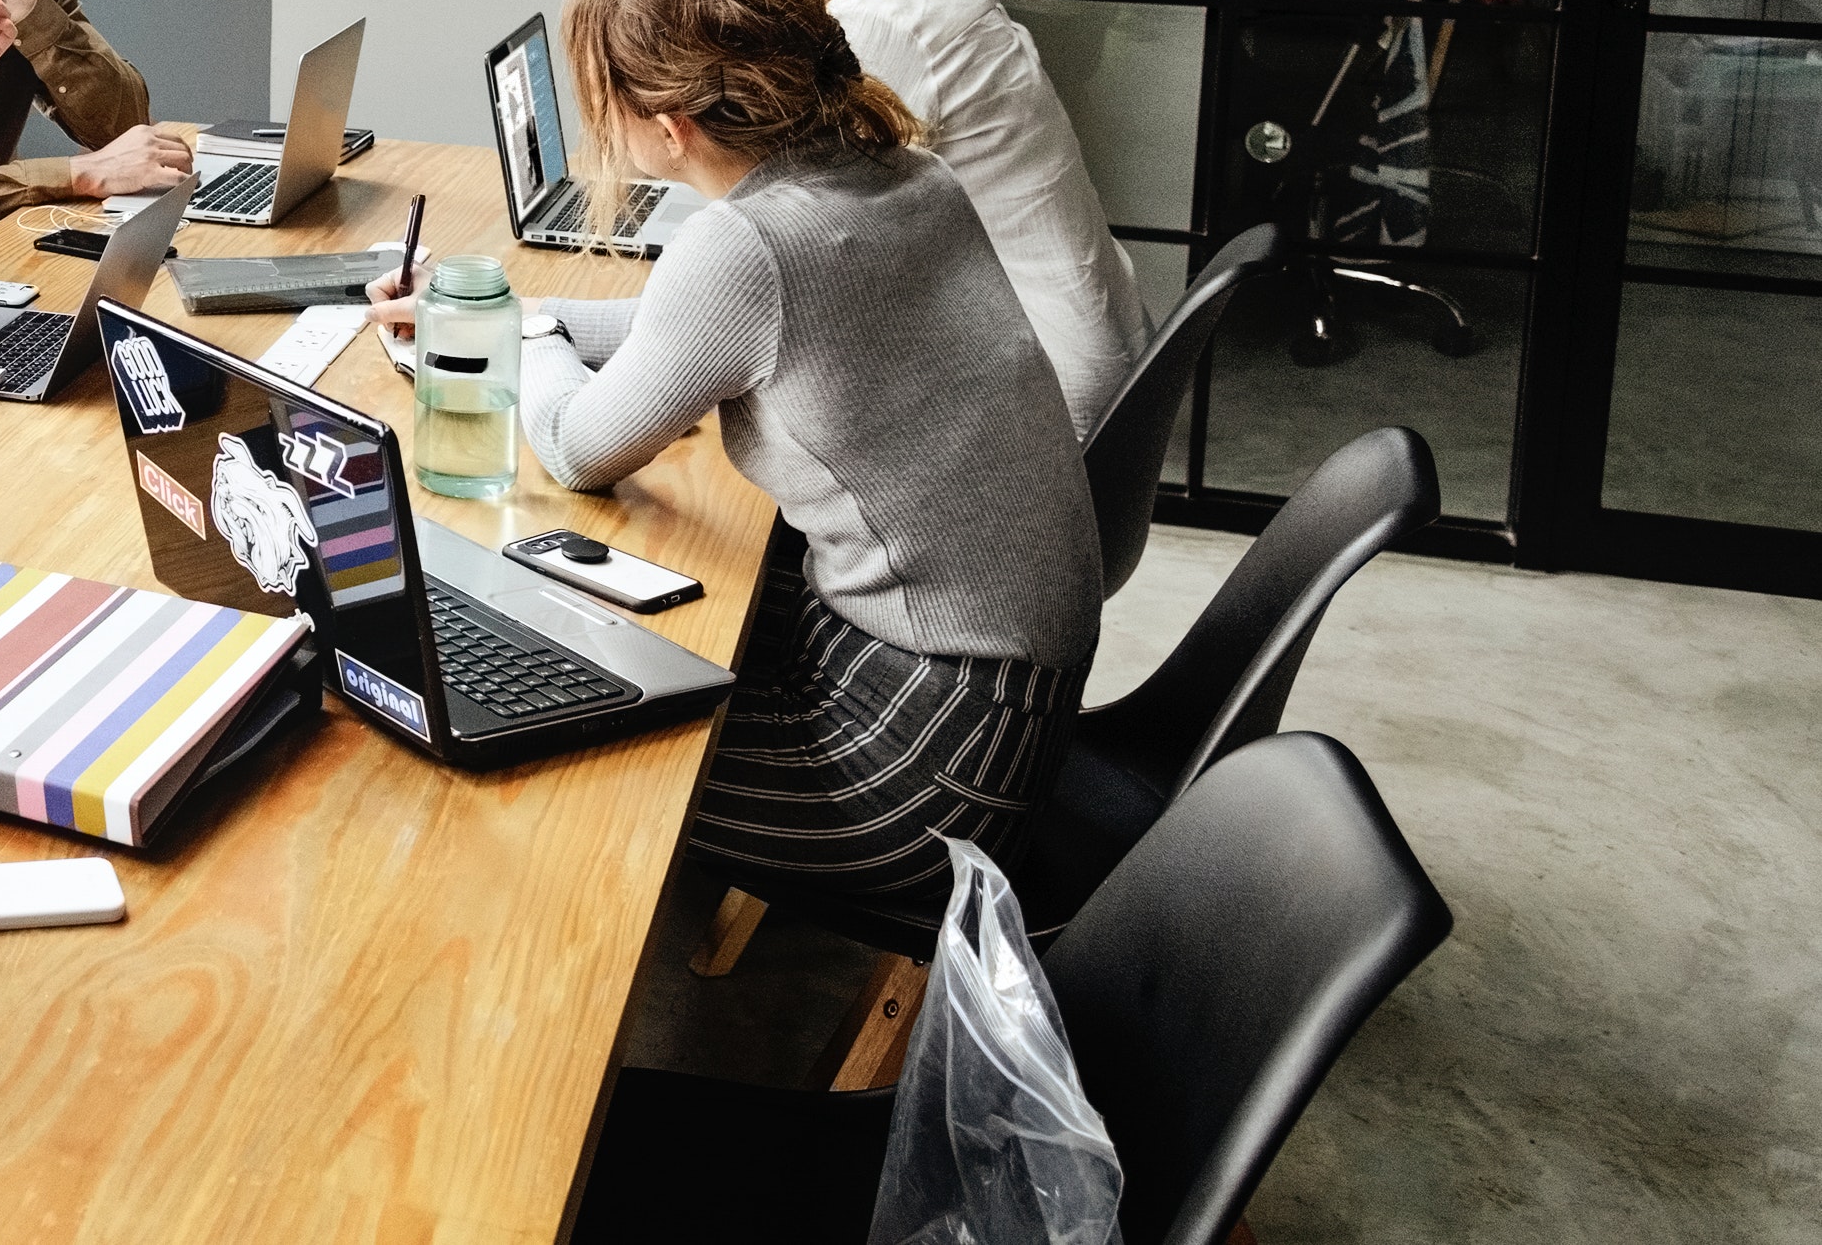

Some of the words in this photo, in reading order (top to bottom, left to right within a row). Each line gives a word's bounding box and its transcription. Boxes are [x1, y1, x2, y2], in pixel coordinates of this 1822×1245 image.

[116, 340, 164, 381] GOOD
[131, 376, 182, 416] LUCK
[143, 465, 198, 529] Click
[346, 668, 420, 724] original
